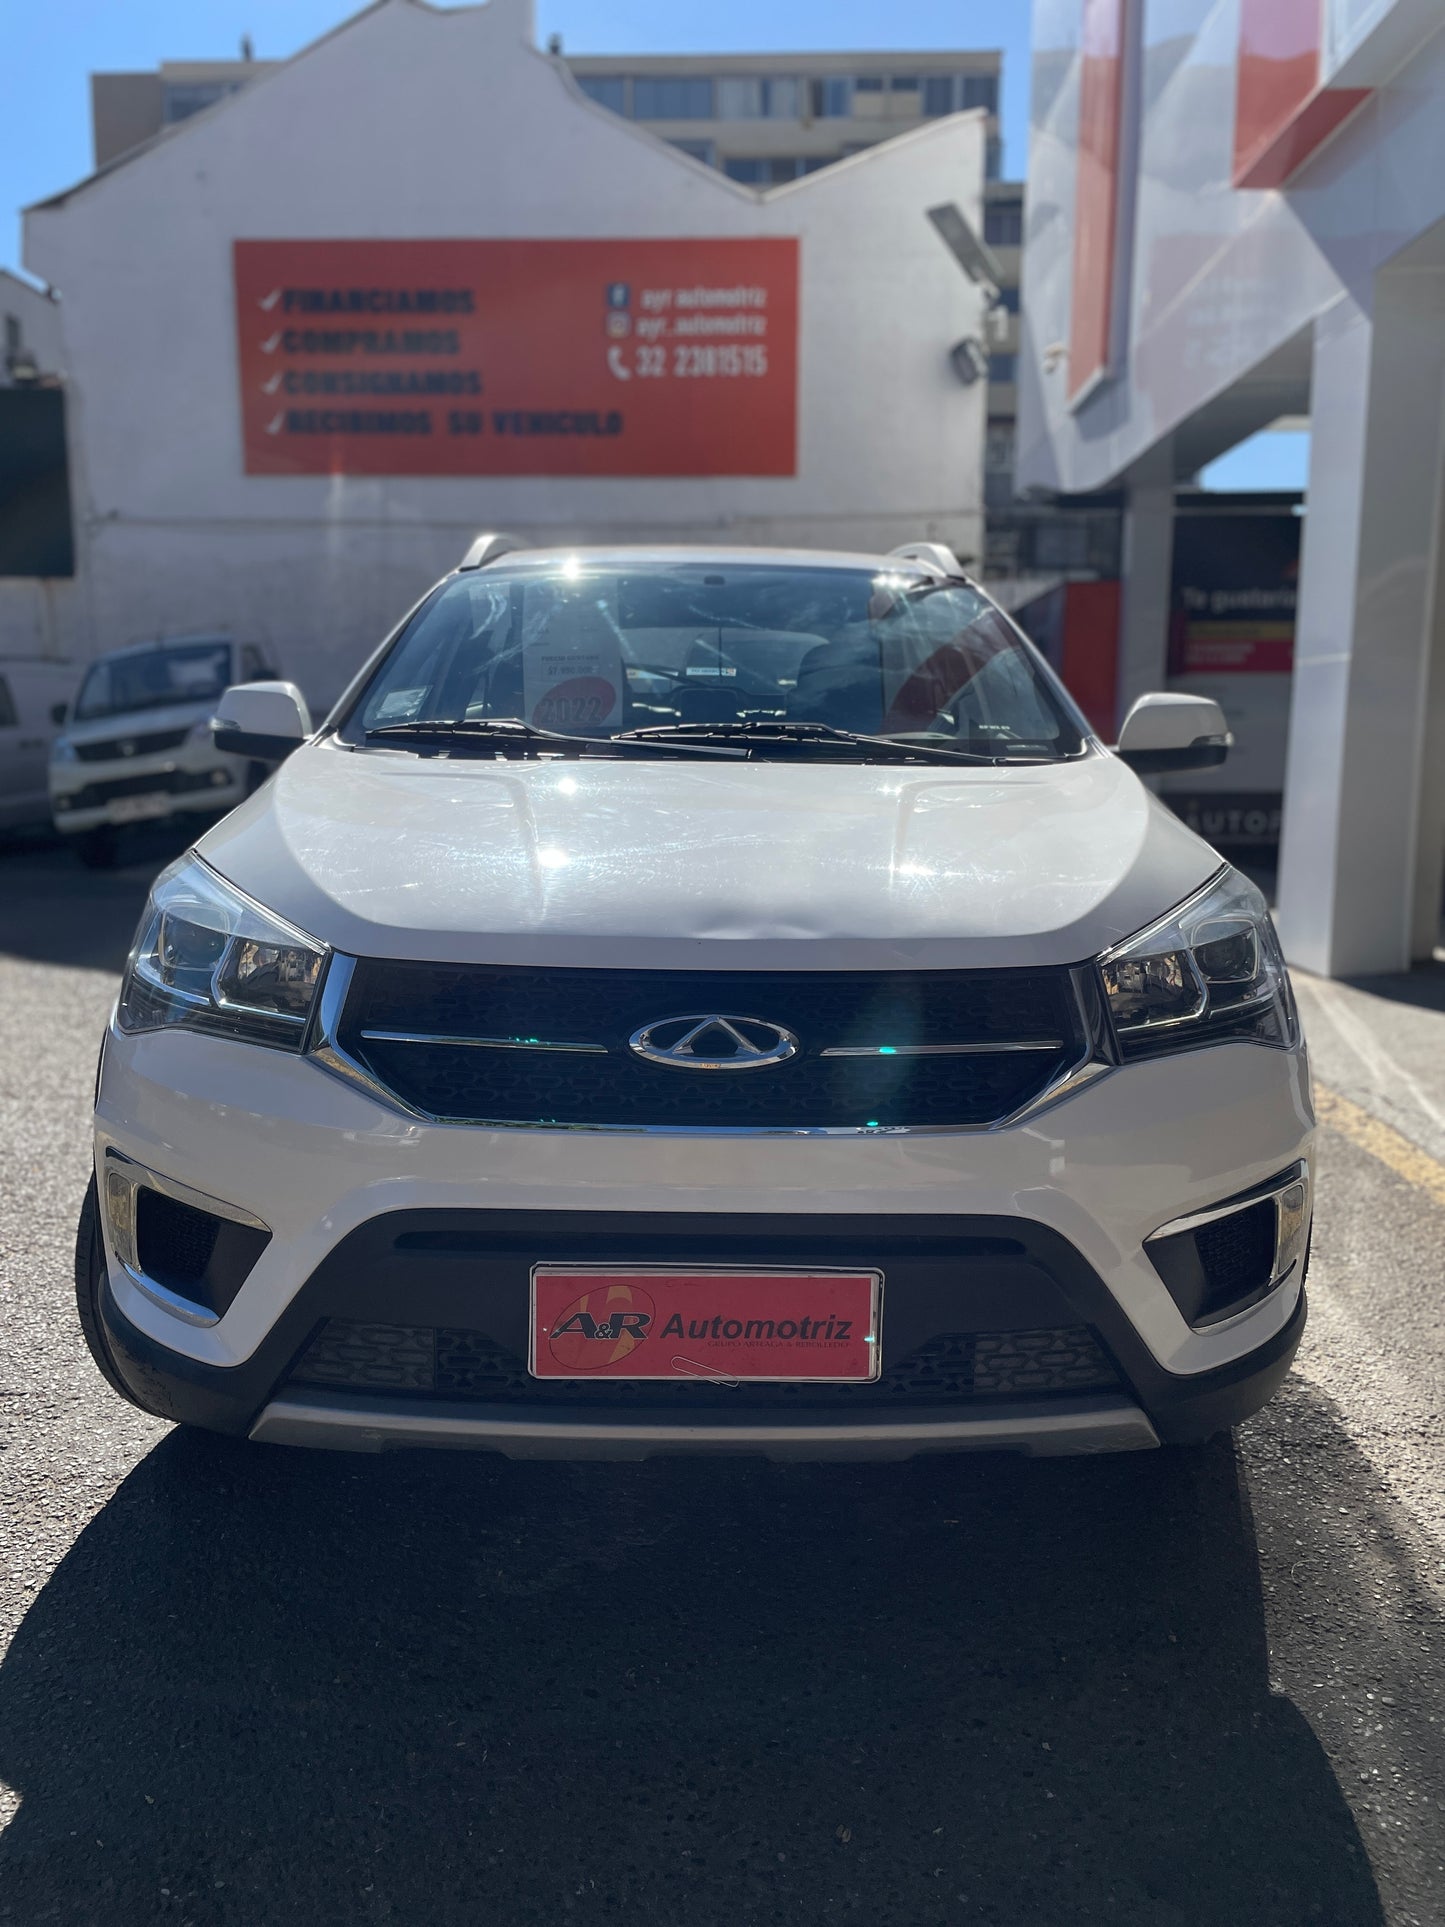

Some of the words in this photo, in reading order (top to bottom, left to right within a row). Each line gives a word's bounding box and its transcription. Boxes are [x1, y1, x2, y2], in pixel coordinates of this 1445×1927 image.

[282, 288, 475, 313] FINANCIAMOS
[674, 284, 768, 308] automotriz
[282, 330, 459, 354] COMPRAMOS
[635, 344, 666, 377] 32
[284, 371, 481, 395] CONSIGNAMOS
[286, 411, 431, 435] RECIBIMOS
[448, 411, 482, 435] SU
[1181, 586, 1207, 610] Te
[540, 696, 602, 724] 2022
[549, 1311, 651, 1340] A&R
[660, 1313, 853, 1340] Automotriz
